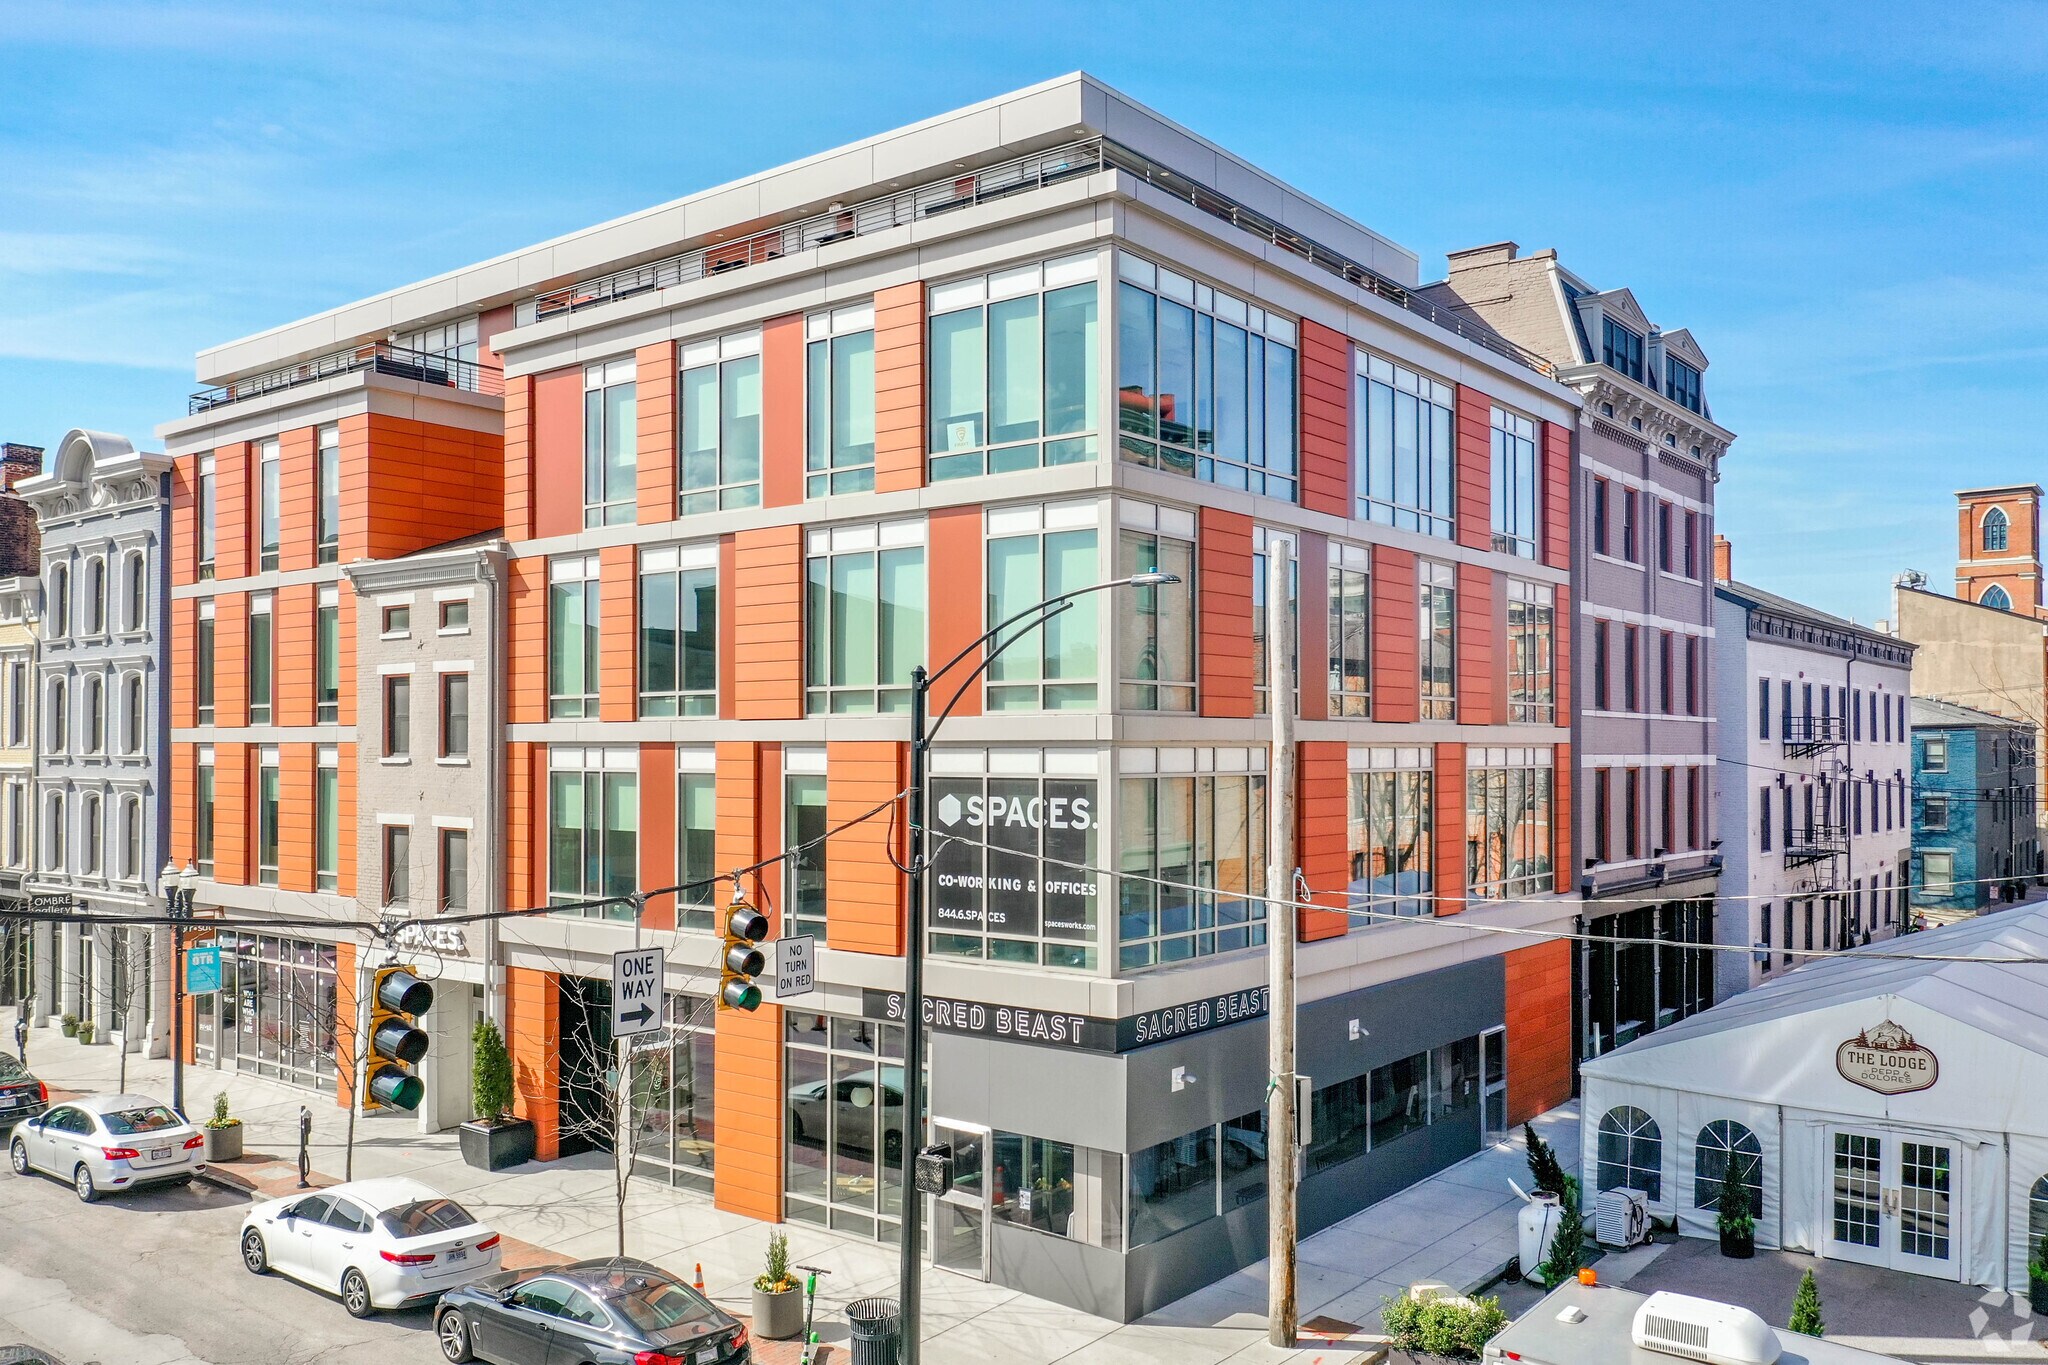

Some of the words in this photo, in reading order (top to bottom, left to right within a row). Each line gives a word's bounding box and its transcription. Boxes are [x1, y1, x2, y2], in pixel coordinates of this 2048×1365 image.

[966, 795, 1098, 830] SPACES.
[938, 874, 1022, 891] CO-WORKING
[1027, 879, 1037, 893] &
[1045, 881, 1097, 896] OFFICES
[34, 894, 71, 906] OMBRÉ
[938, 908, 1006, 923] 844.6.SPACES
[1044, 920, 1096, 931] spacesworks.com
[789, 945, 803, 956] NO
[192, 955, 213, 966] OTR
[622, 956, 654, 977] ONE
[785, 959, 807, 972] TURN
[780, 978, 792, 989] ON
[795, 974, 811, 987] RED
[622, 978, 655, 1000] WAY
[243, 999, 253, 1008] ARE
[242, 1007, 255, 1016] WHO
[886, 993, 986, 1030] SCRED
[996, 1008, 1085, 1043] BEAST
[1135, 1001, 1210, 1042] SACRED
[1216, 987, 1270, 1023] BEAST
[243, 1025, 253, 1034] ARE
[1847, 1051, 1875, 1065] THE
[1880, 1054, 1927, 1071] LODGE
[1861, 1072, 1912, 1084] DOLORES
[1871, 1067, 1900, 1076] PEPP
